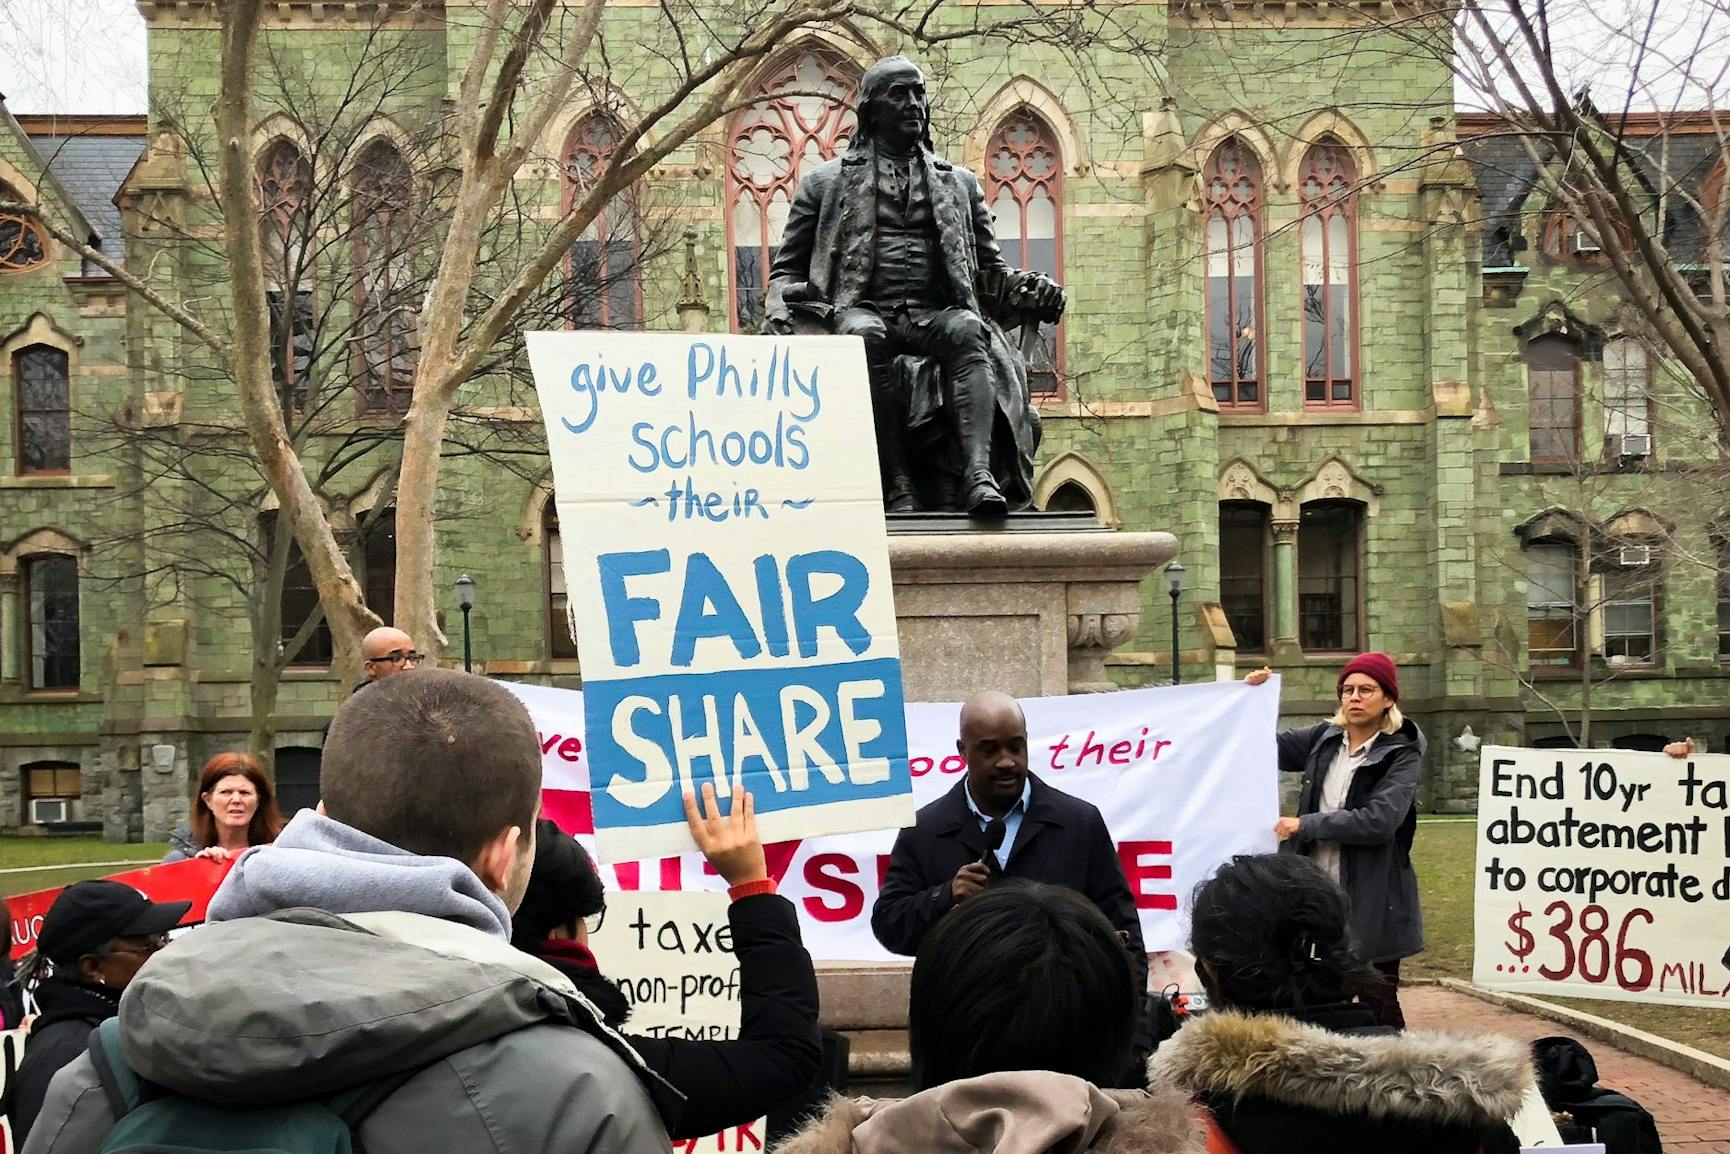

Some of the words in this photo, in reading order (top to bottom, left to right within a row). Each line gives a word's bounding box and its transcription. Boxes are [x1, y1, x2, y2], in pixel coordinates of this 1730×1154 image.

[561, 354, 662, 434] give
[687, 342, 821, 422] Philly
[596, 548, 872, 668] FAIR
[606, 678, 892, 808] SHARE
[1048, 727, 1172, 770] their
[1491, 759, 1565, 800] End
[1678, 761, 1728, 811] ta
[1486, 806, 1707, 855] abatement
[1485, 857, 1527, 891] to
[1537, 863, 1704, 903] corporate
[629, 907, 735, 955] taxe
[616, 967, 740, 1015] non-prof
